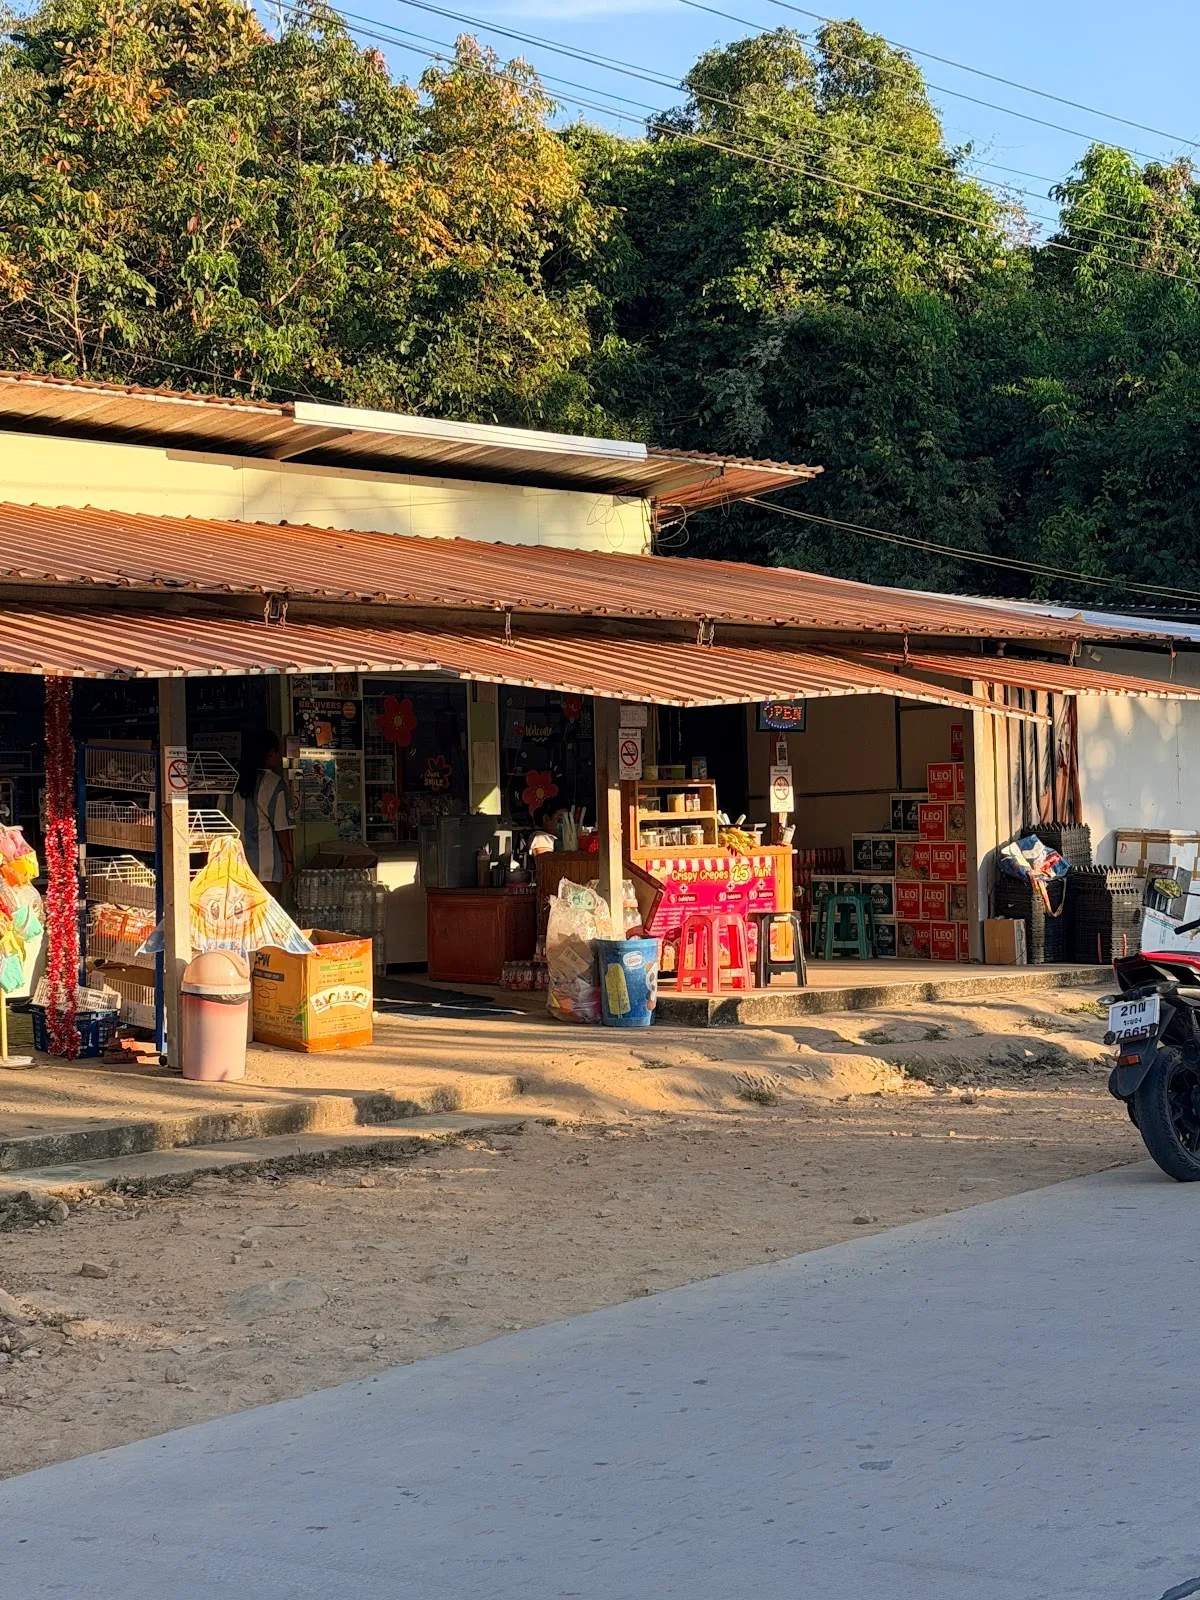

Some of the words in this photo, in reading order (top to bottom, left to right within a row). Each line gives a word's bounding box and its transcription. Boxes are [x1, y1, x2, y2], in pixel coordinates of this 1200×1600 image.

[931, 770, 950, 782] LEO
[922, 811, 941, 822] LEO
[934, 851, 952, 862] LEO
[671, 869, 698, 882] Crispy
[699, 869, 729, 881] Crepes
[732, 864, 749, 882] 25
[900, 889, 917, 900] LEO
[925, 890, 943, 901] LEO
[935, 930, 953, 940] LEO
[1115, 1025, 1148, 1041] 7665
